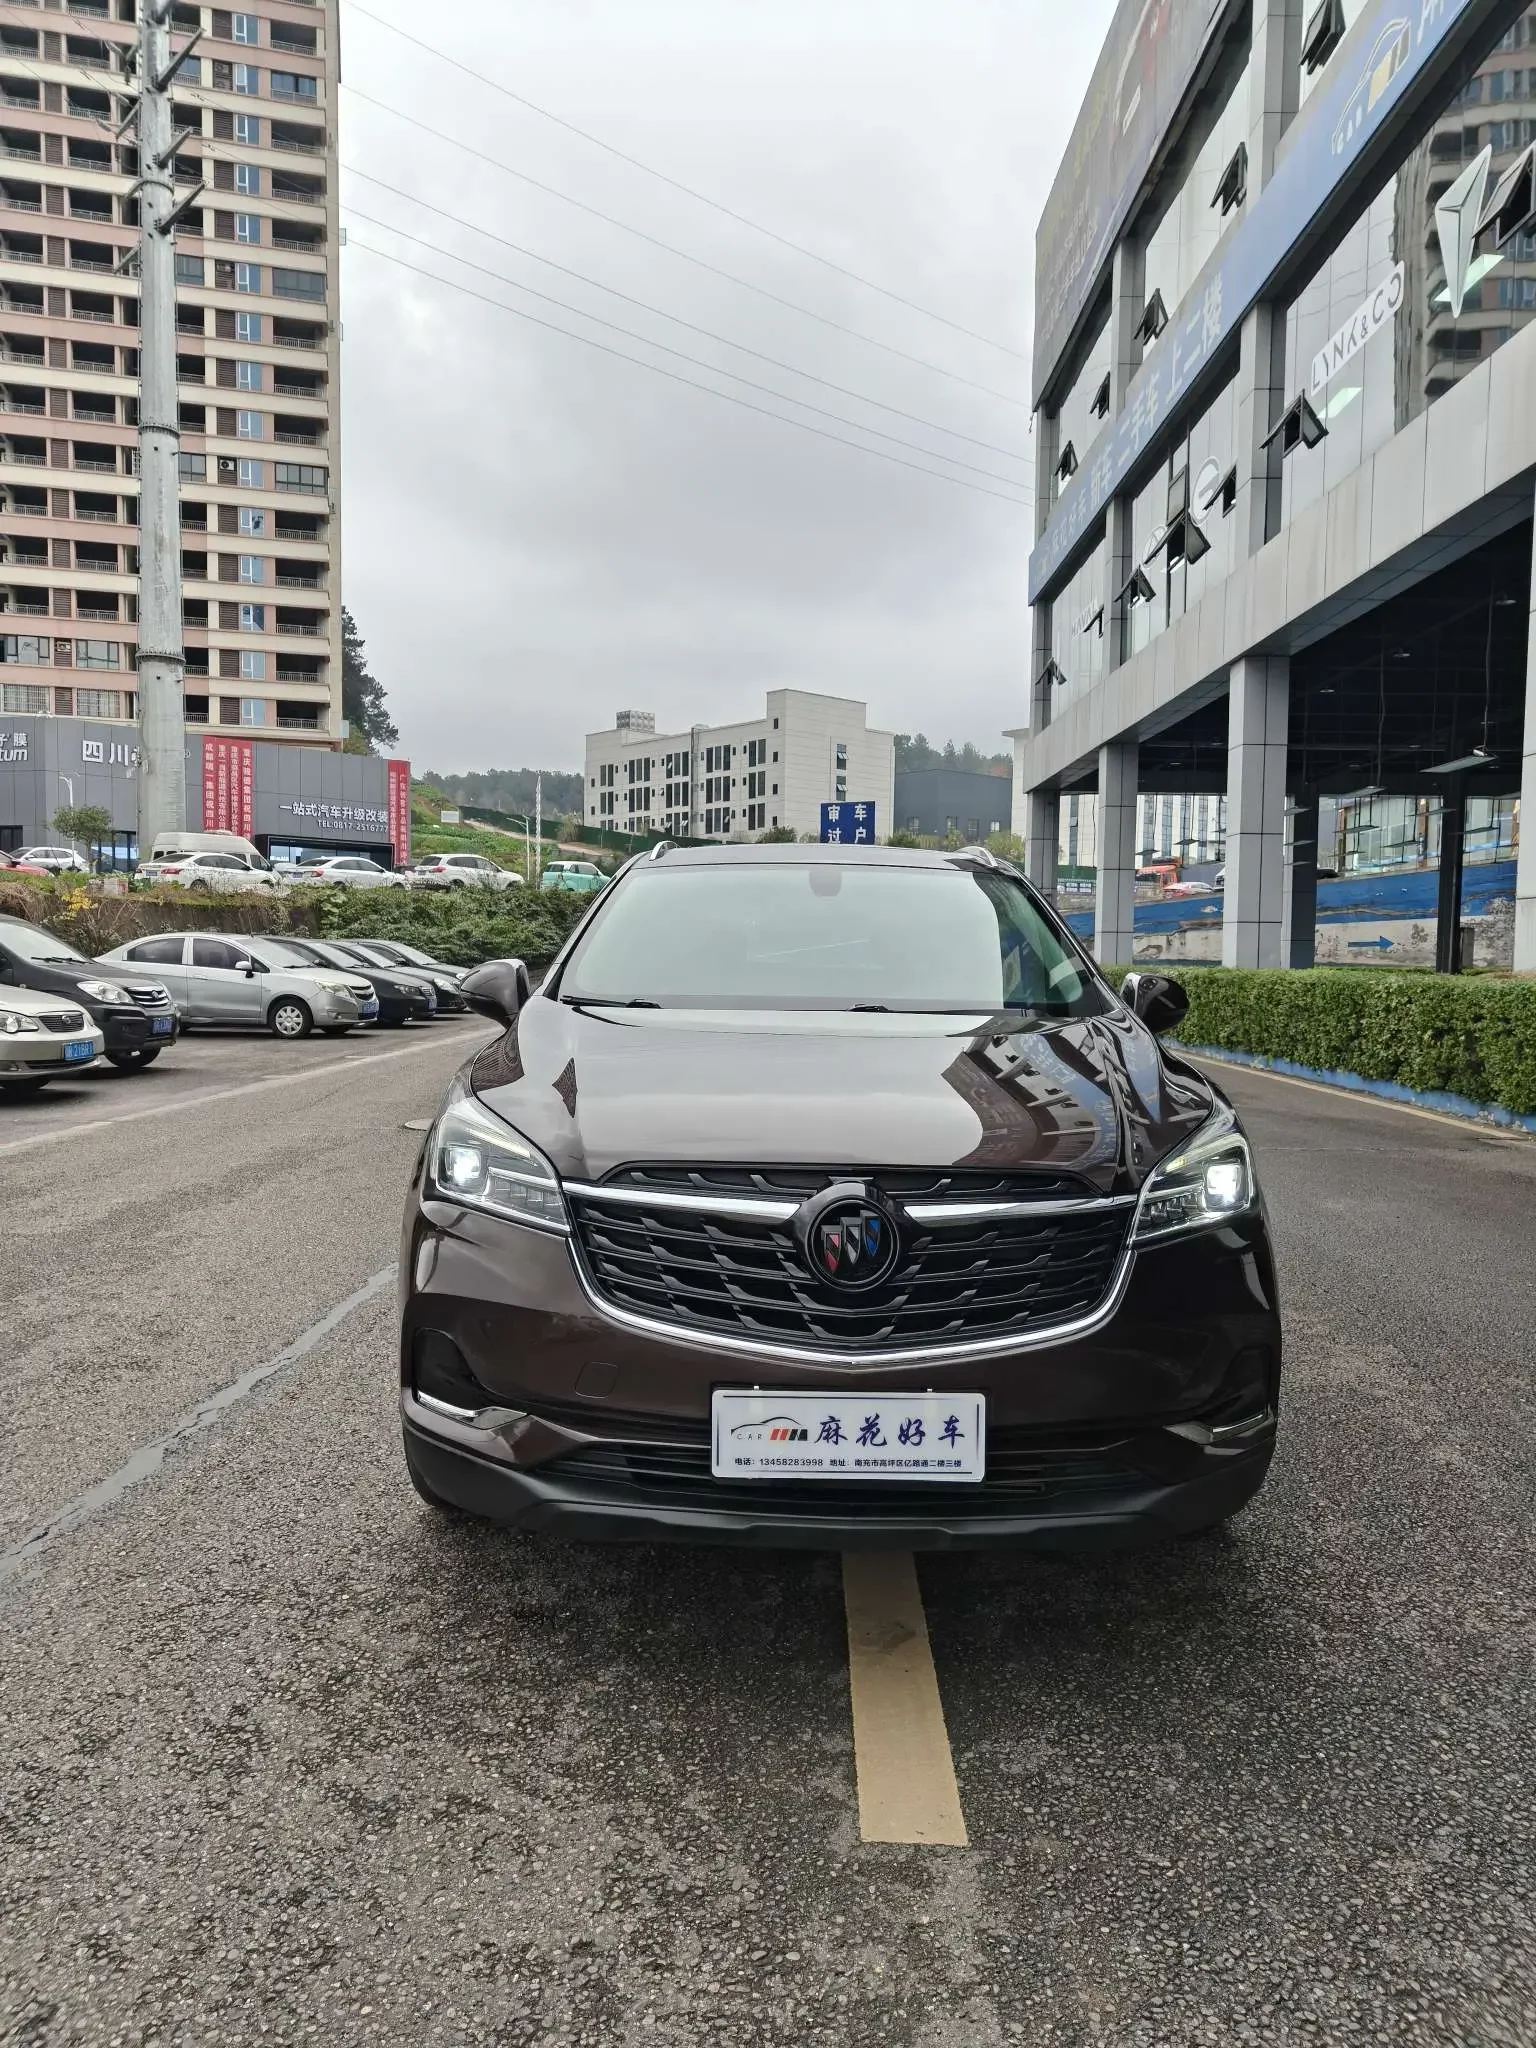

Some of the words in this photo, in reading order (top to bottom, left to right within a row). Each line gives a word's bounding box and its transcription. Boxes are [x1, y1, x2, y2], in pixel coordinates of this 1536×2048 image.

[1117, 368, 1161, 468] 二手车
[1164, 269, 1223, 405] 上二楼
[279, 801, 388, 823] 一站式汽车升级改装
[737, 1433, 763, 1441] CAR
[814, 1412, 965, 1449] 麻花好车
[760, 1458, 824, 1467] 13458283998
